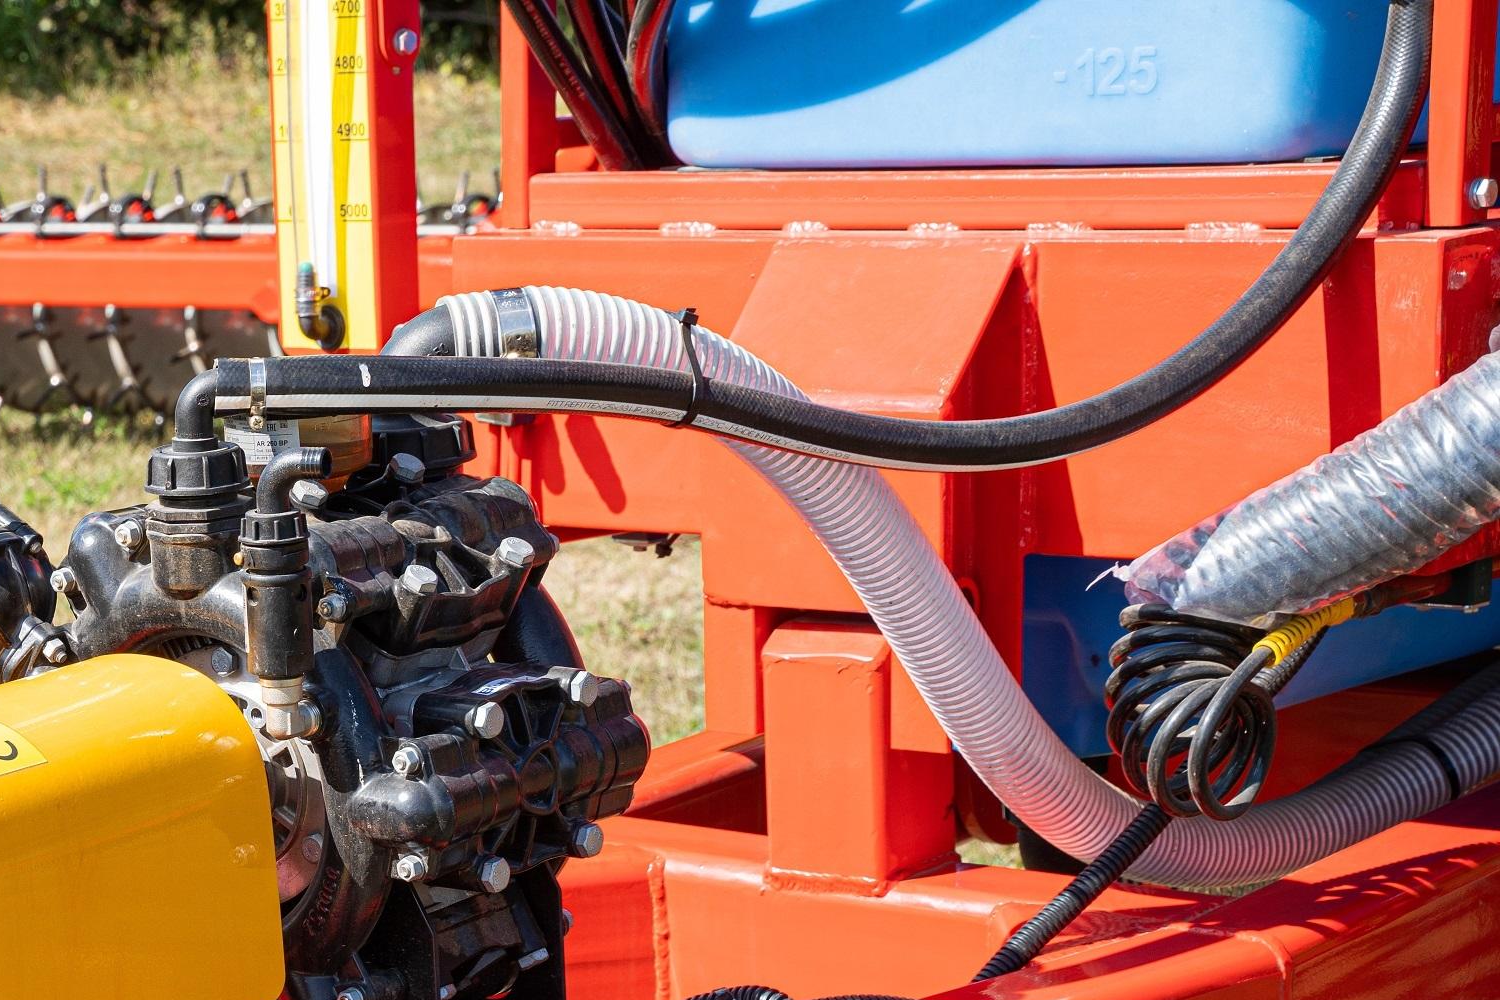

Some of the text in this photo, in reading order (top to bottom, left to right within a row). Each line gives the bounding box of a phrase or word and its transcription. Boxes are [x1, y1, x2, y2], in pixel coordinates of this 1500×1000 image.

[333, 1, 361, 14] 4700
[335, 56, 364, 70] 4800
[1075, 46, 1159, 97] 125
[337, 123, 366, 137] 4900
[340, 204, 368, 218] 5000
